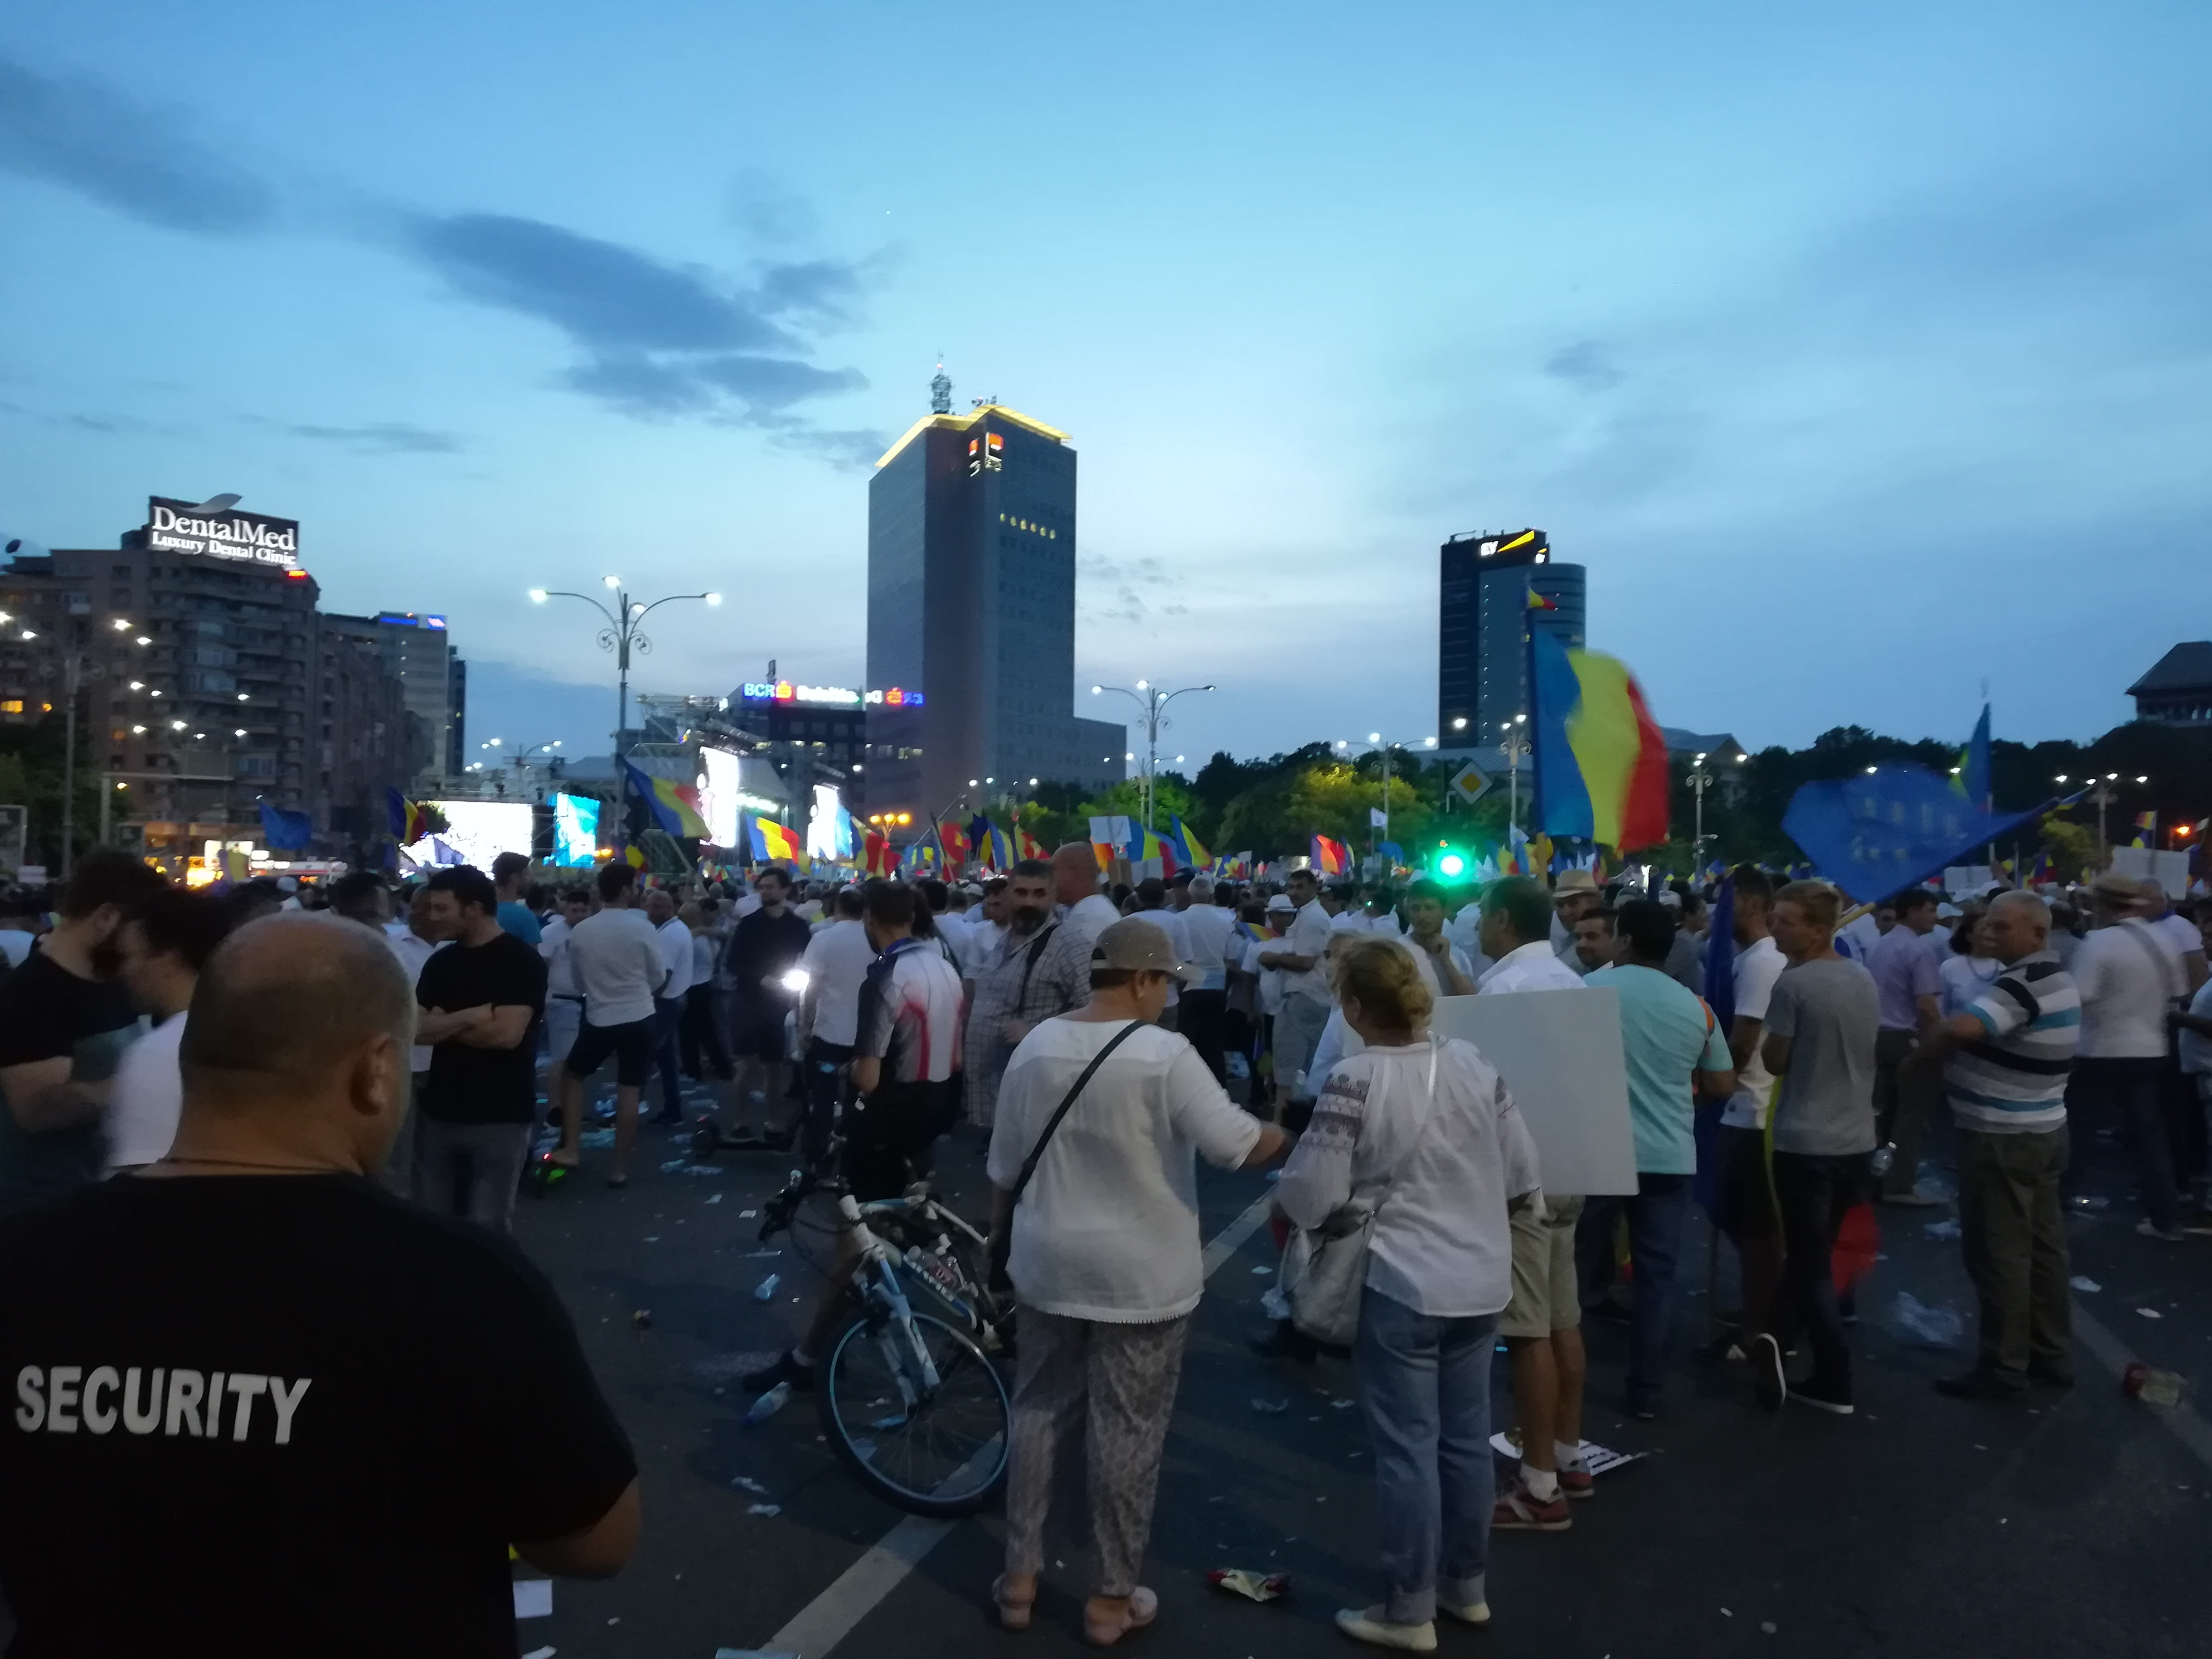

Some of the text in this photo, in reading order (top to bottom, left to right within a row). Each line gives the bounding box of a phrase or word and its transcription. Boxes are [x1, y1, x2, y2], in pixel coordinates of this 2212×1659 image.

[152, 506, 297, 551] DentalMed
[152, 531, 297, 565] Luxury Dental Clinic
[1481, 541, 1498, 556] EY
[14, 1365, 312, 1445] SECURITY
